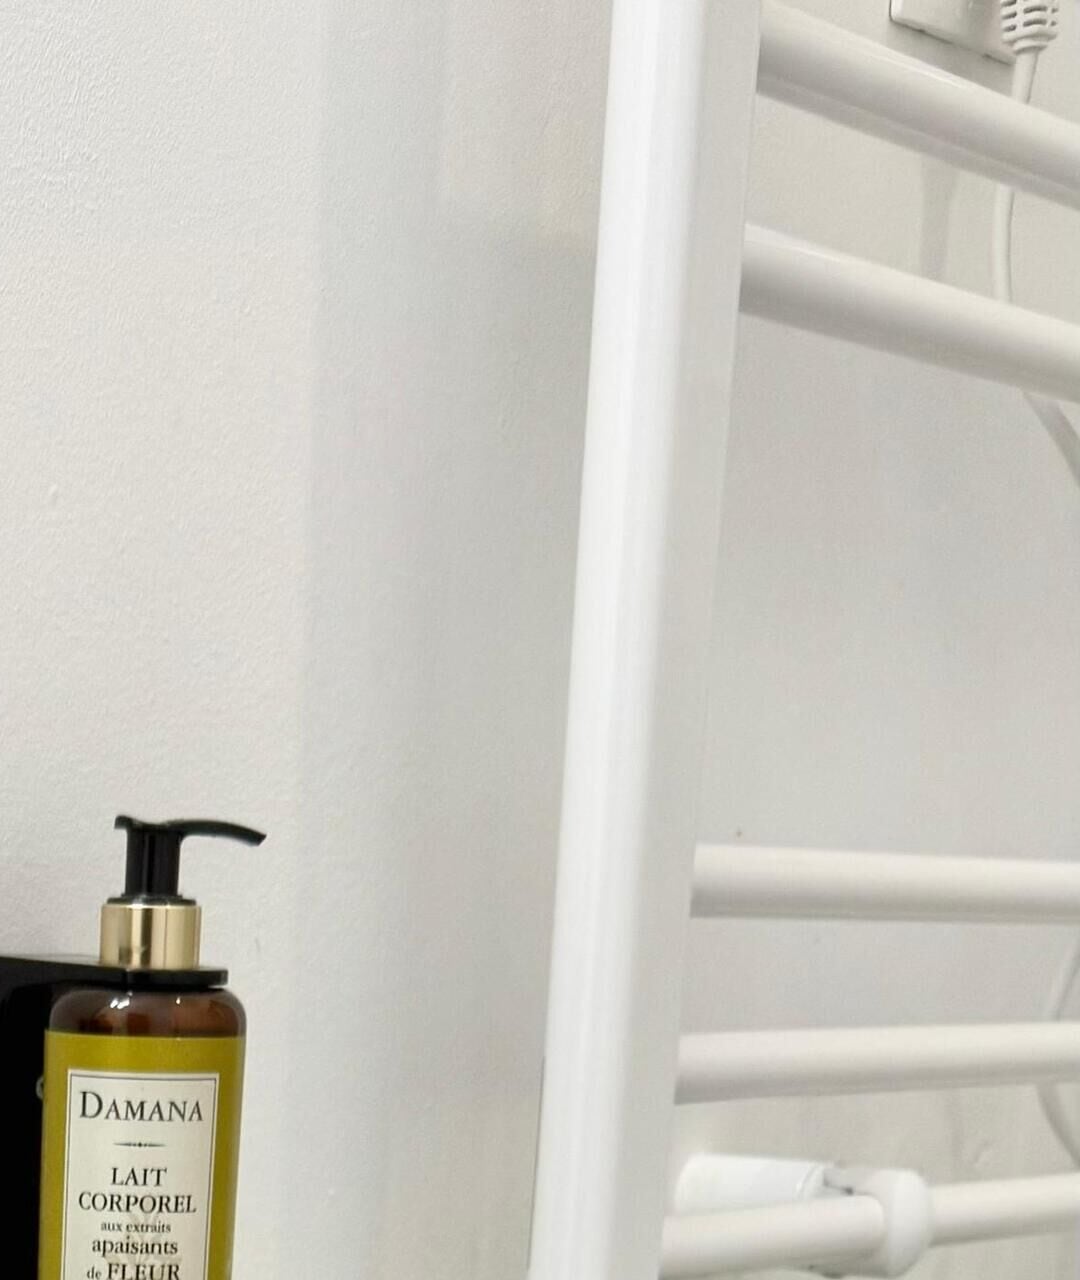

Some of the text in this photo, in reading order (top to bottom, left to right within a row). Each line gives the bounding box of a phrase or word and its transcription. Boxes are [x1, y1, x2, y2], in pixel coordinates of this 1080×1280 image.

[79, 1090, 204, 1122] DAMANA
[111, 1167, 168, 1187] LAIT
[78, 1191, 197, 1214] CORPOREL
[101, 1221, 172, 1234] aux extraits
[92, 1236, 178, 1258] apaisants
[86, 1266, 102, 1280] de
